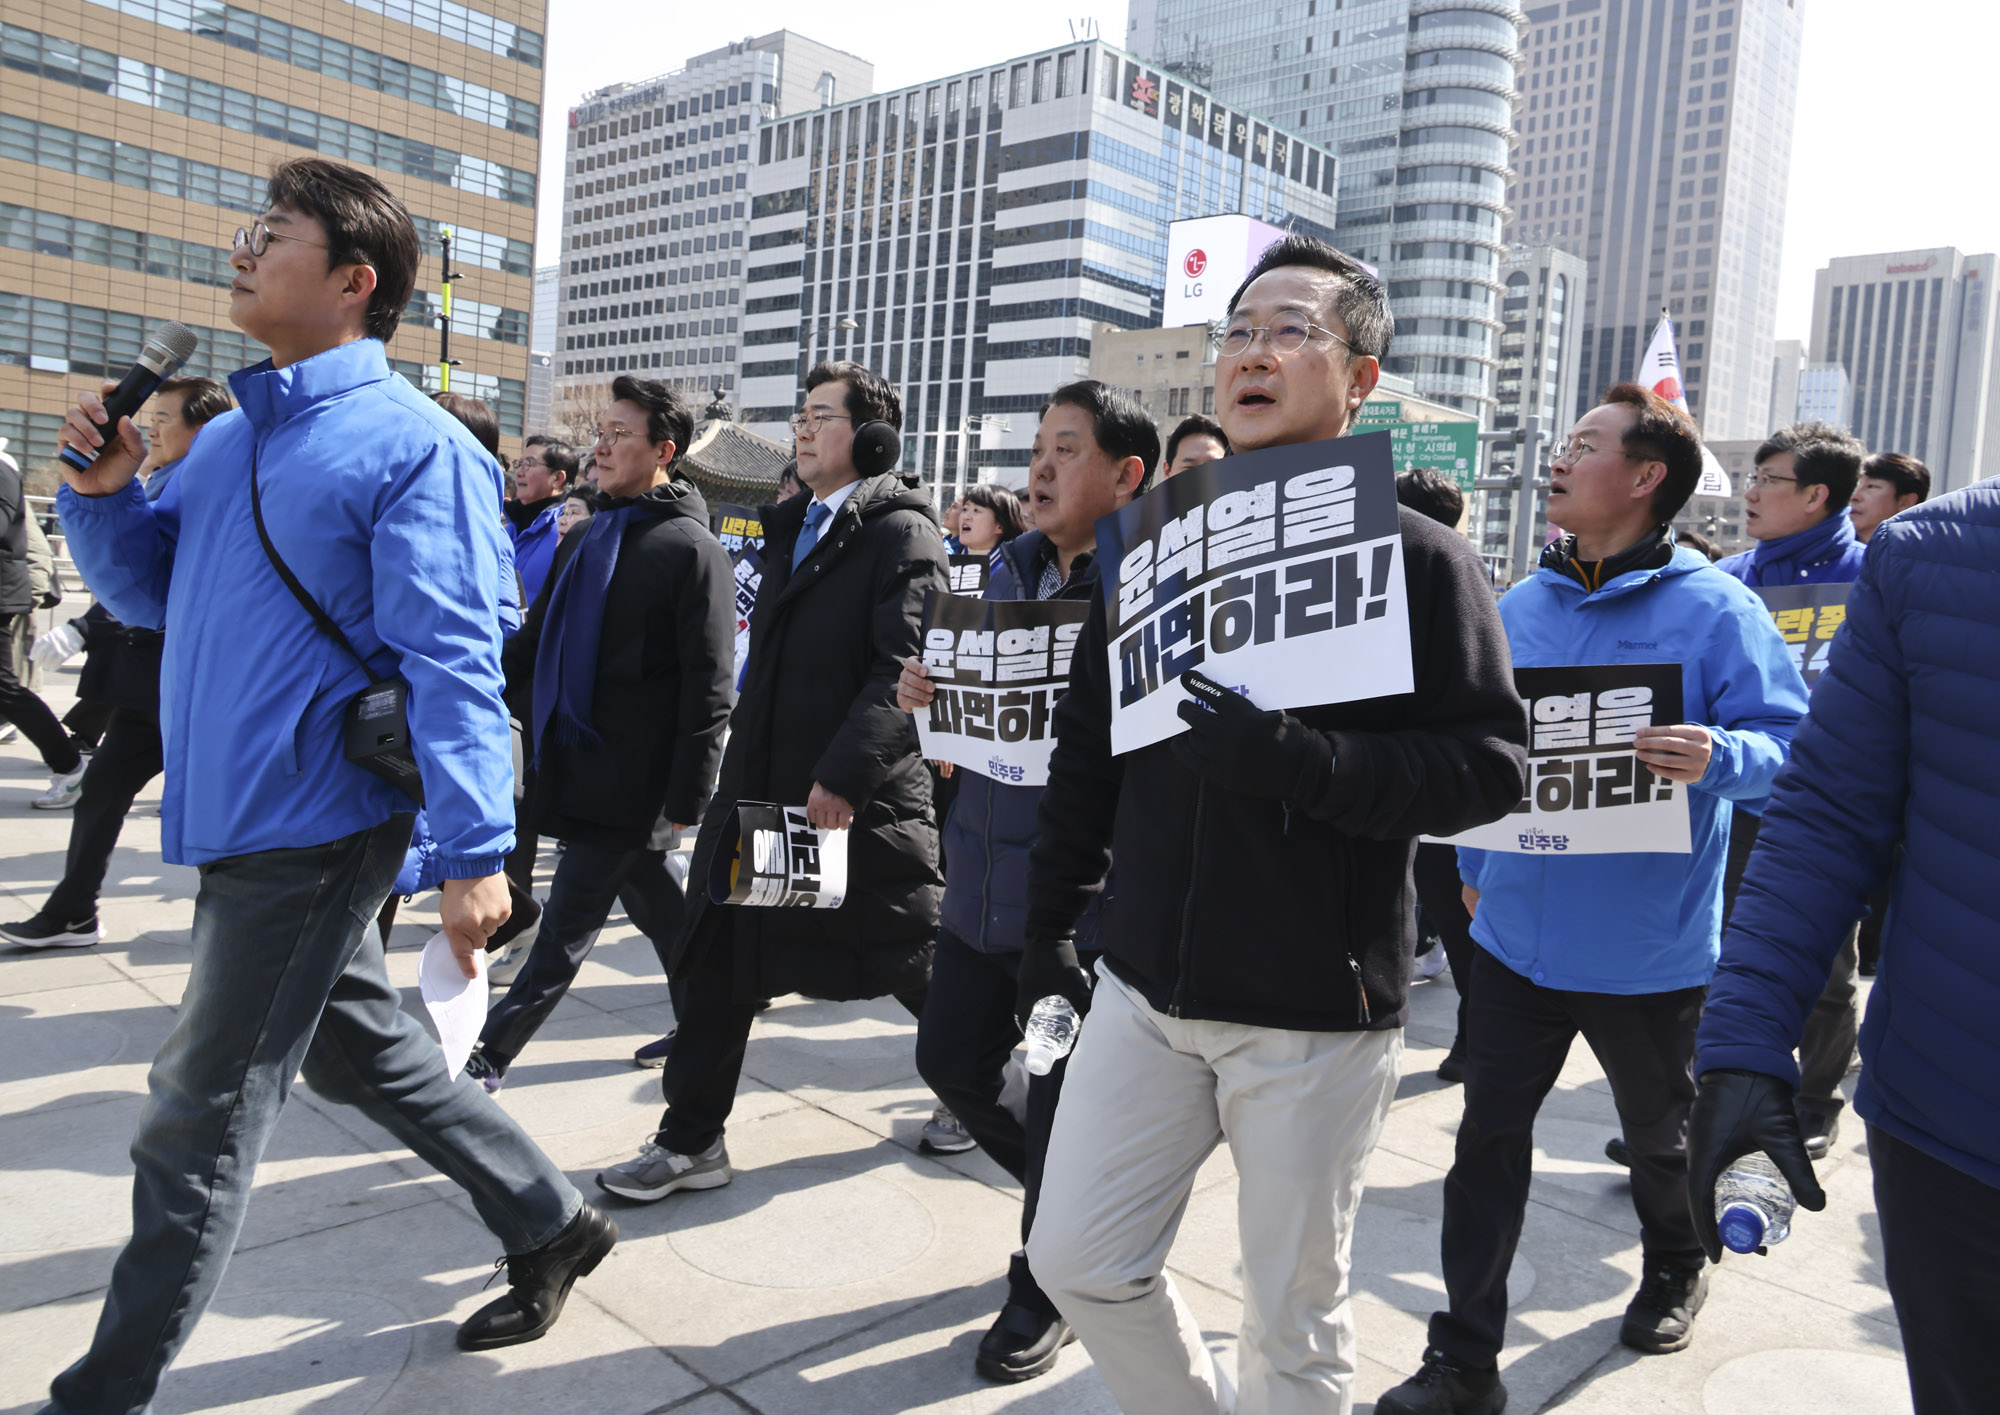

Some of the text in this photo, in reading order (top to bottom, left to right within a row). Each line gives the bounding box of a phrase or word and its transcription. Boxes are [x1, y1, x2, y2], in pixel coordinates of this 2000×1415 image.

[1184, 283, 1203, 299] LG
[1389, 428, 1408, 439] 례문
[1119, 465, 1357, 627] 윤석열을
[1120, 542, 1394, 710] 파면하라!
[929, 686, 1069, 743] 파면하
[1522, 686, 1653, 749] 열을
[989, 760, 1025, 782] 민주당
[1518, 834, 1570, 851] 민주당
